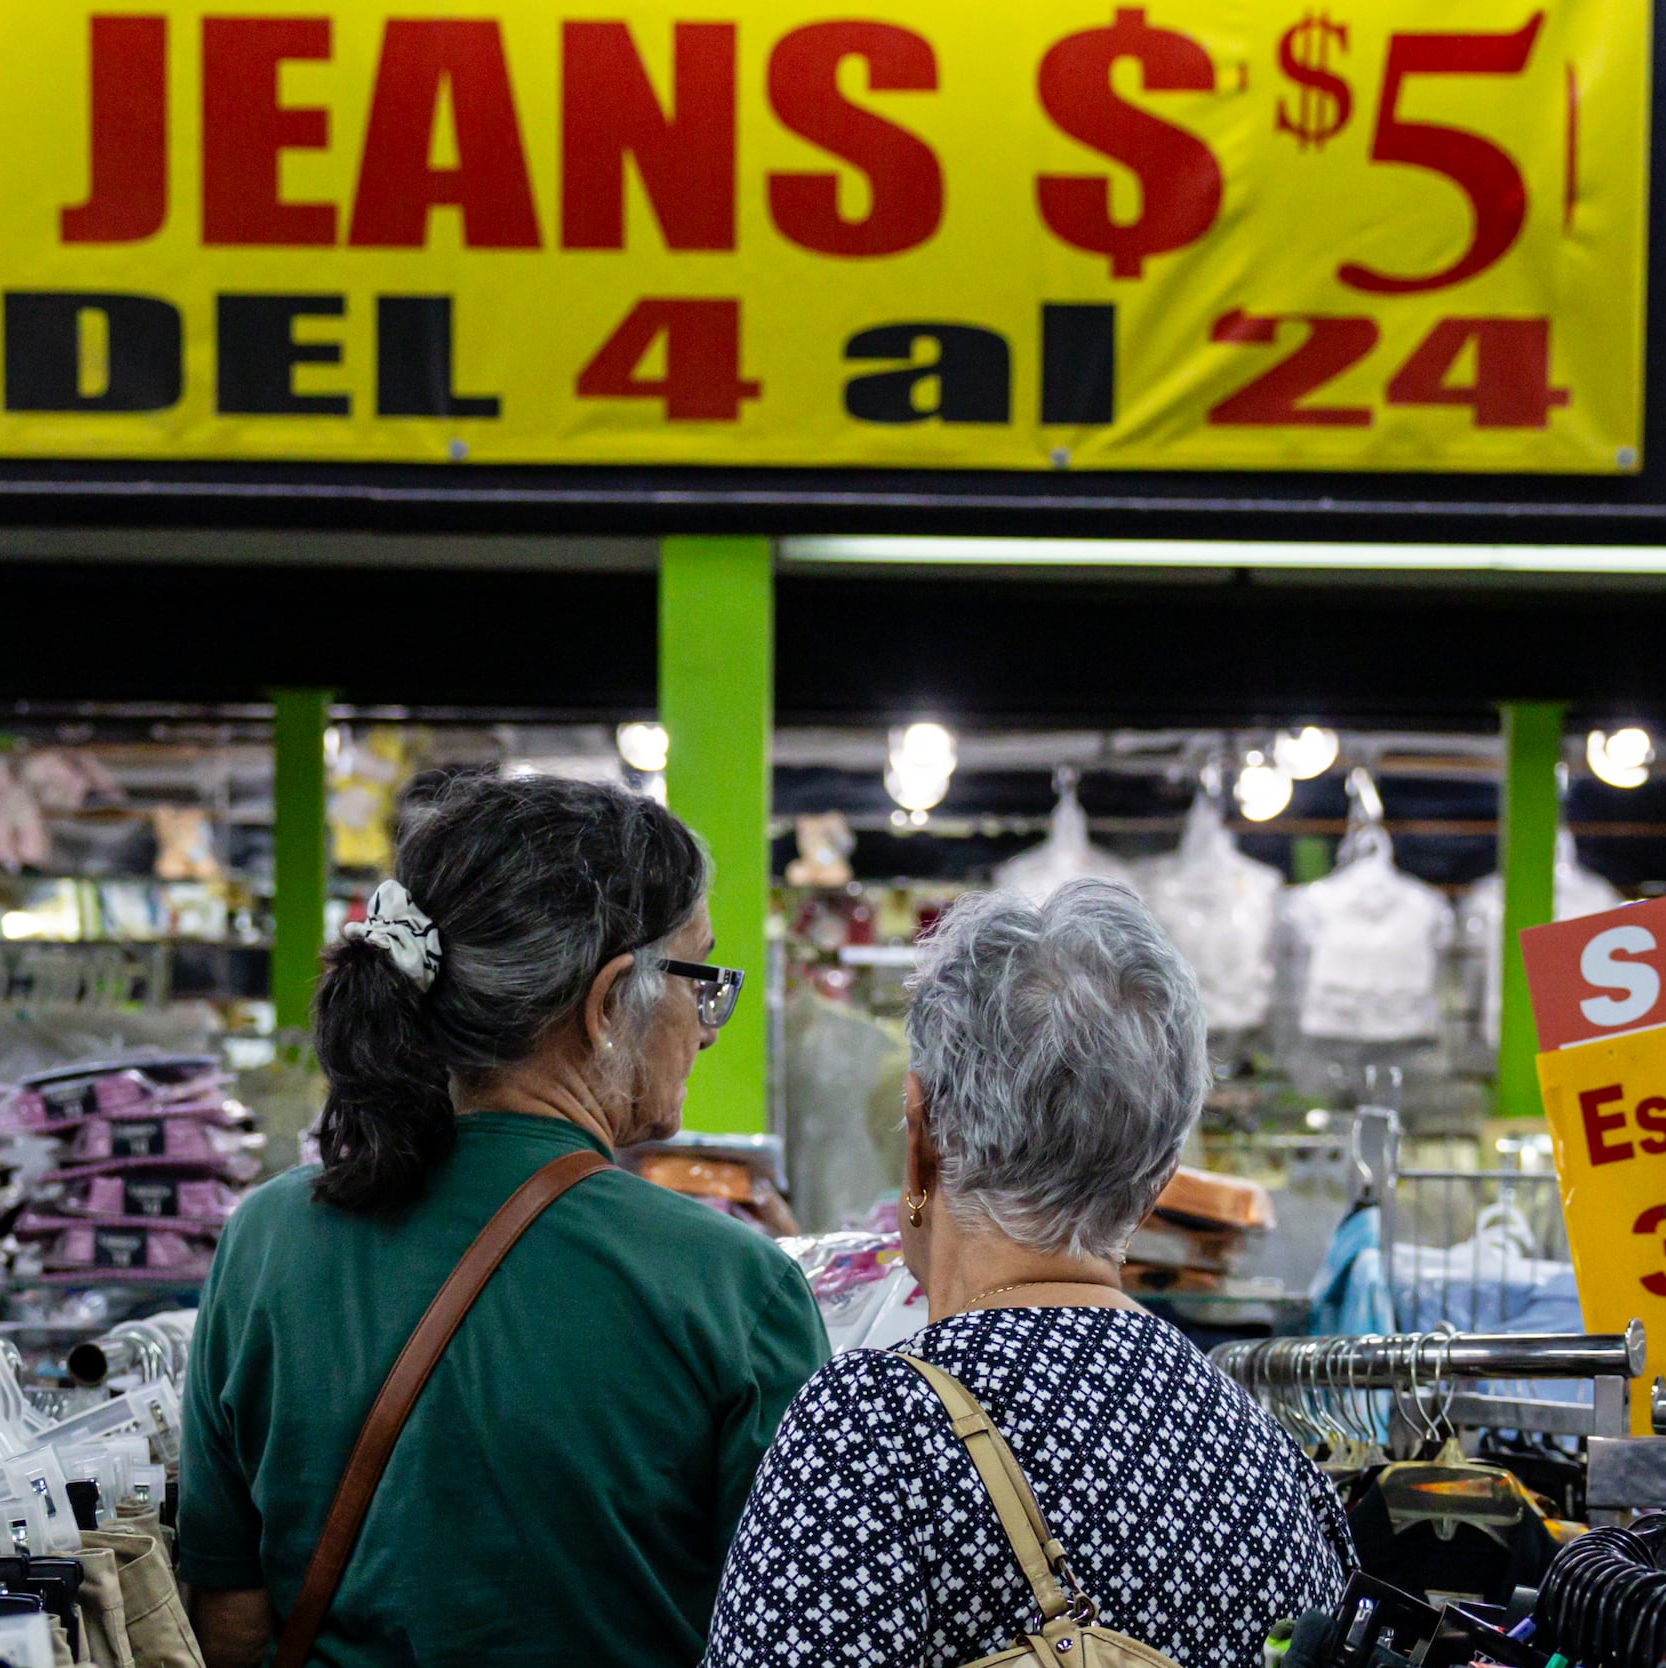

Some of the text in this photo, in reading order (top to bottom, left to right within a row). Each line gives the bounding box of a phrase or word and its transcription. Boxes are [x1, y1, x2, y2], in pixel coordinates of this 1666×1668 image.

[59, 15, 945, 257] JEANS
[1275, 8, 1544, 295] $5
[2, 290, 501, 419] DEL
[575, 296, 761, 422] 4
[842, 302, 1118, 427] al
[1207, 310, 1571, 429] 24
